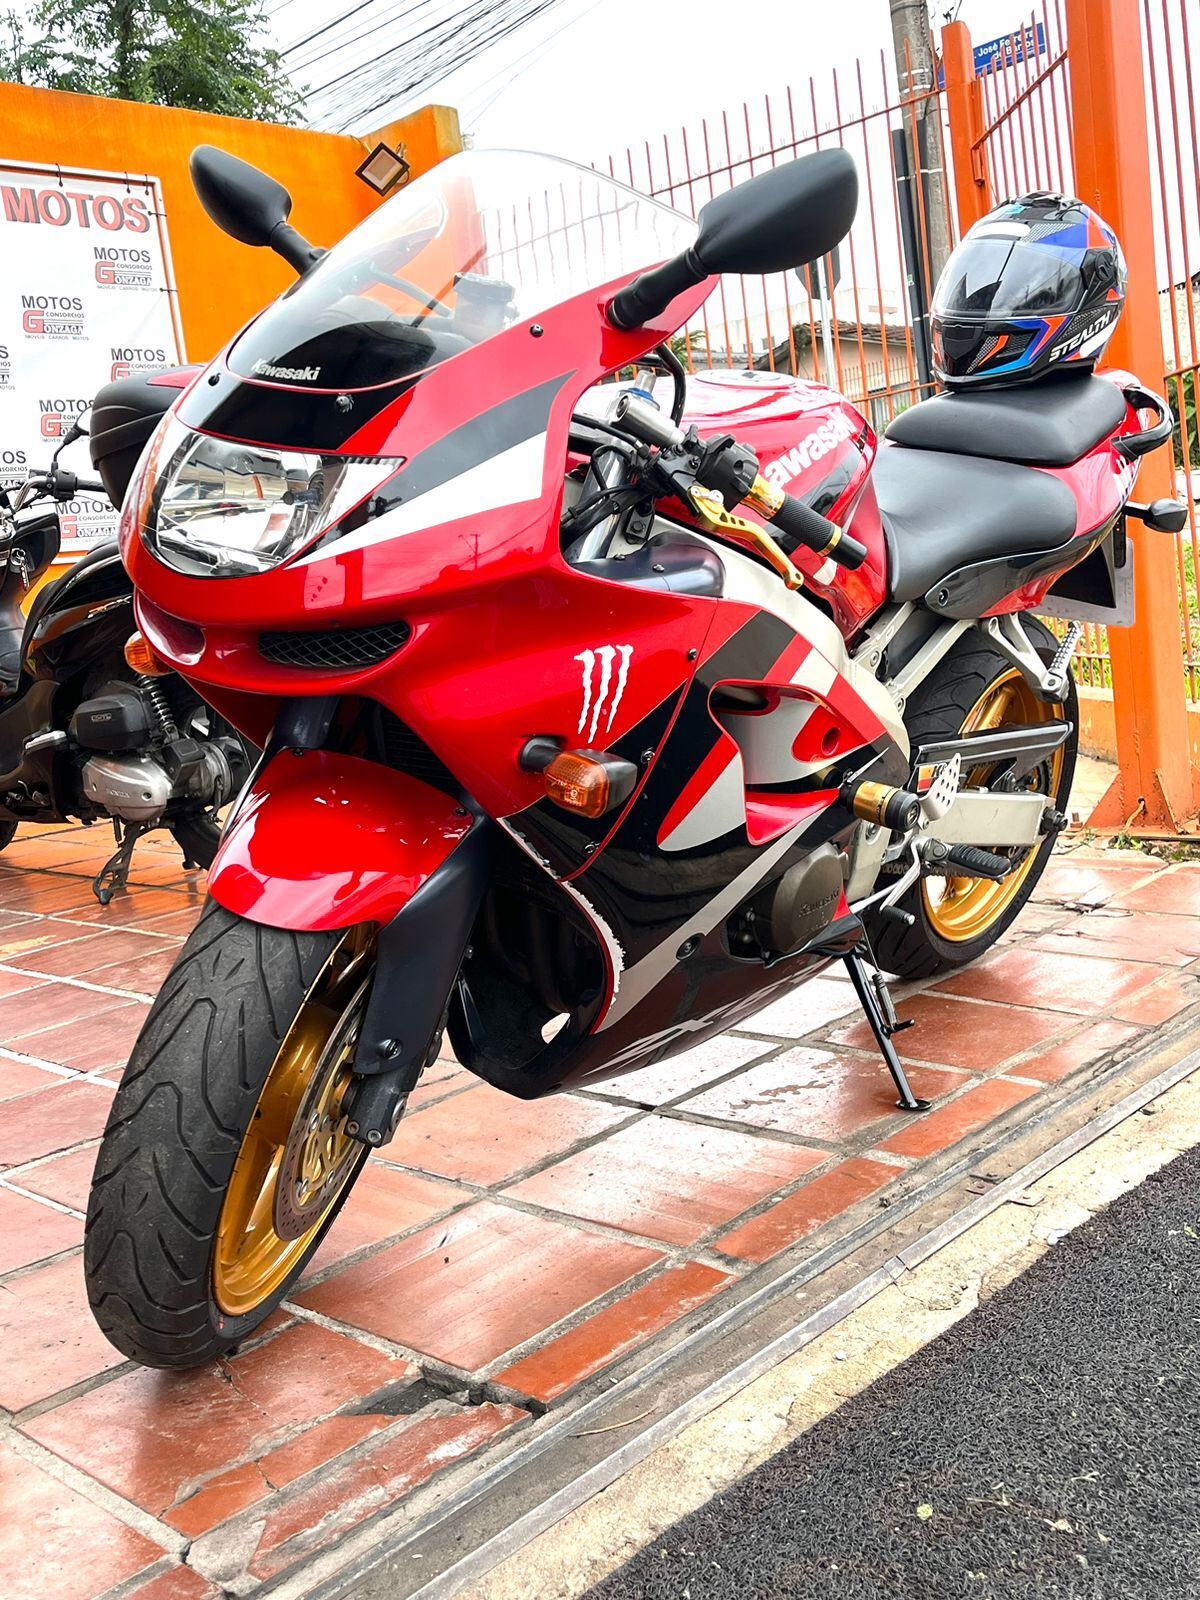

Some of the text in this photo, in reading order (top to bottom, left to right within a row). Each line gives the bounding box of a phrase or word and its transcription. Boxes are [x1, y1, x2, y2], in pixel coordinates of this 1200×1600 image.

[978, 42, 998, 57] José
[1, 186, 150, 233] MOTOS
[94, 247, 151, 263] MOTOS
[21, 295, 83, 310] MOTOS
[1049, 310, 1111, 362] STEALTH
[111, 348, 166, 361] MOTOS
[250, 358, 321, 380] Kawasaki
[764, 405, 858, 490] awasaki
